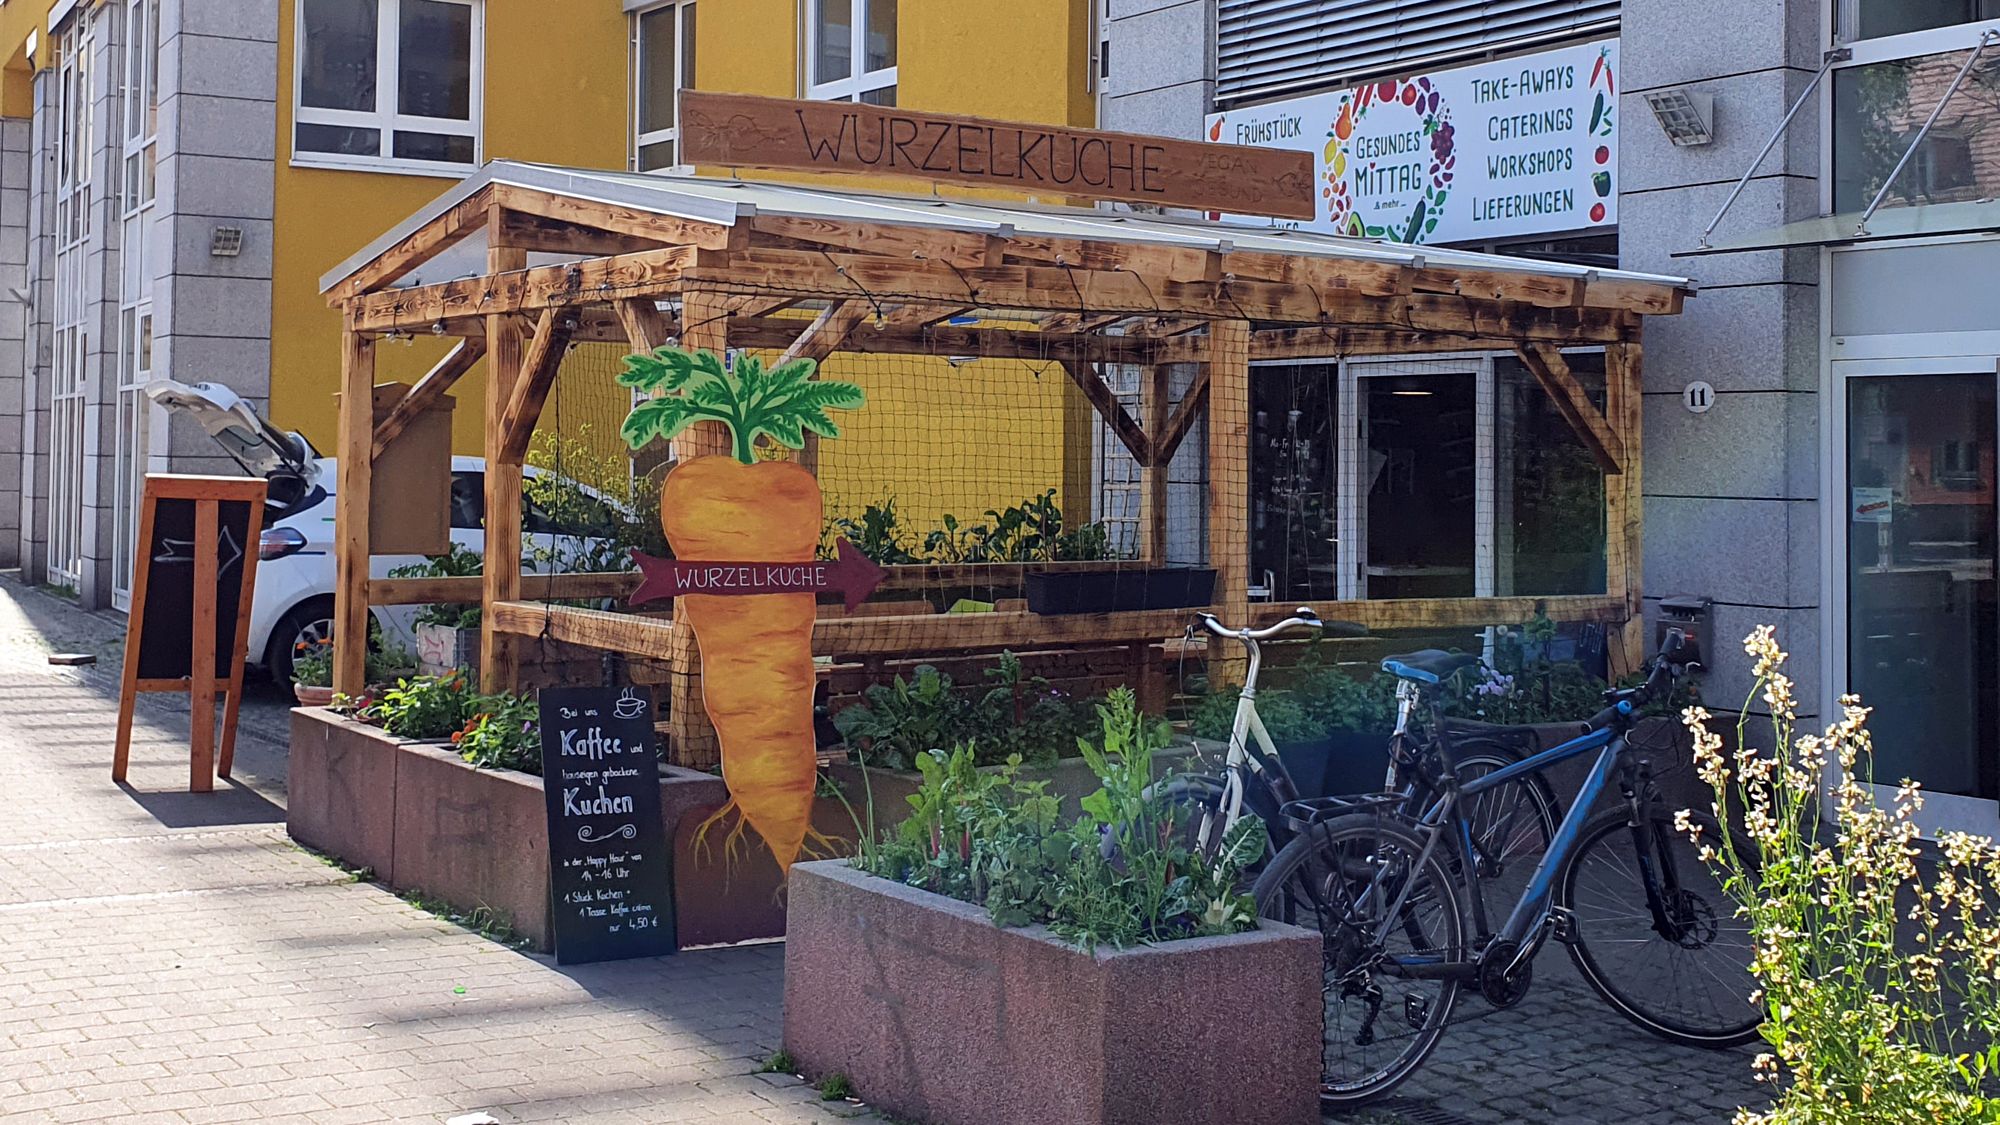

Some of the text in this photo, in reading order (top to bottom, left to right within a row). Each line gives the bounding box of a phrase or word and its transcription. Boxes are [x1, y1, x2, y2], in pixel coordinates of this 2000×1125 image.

[1471, 65, 1574, 104] TAKE-AWAYS
[1236, 113, 1302, 145] FRÜHSTÜCK
[1488, 107, 1573, 142] CATERINGS
[795, 109, 1165, 193] WURZELKÜCHE
[1356, 130, 1420, 159] GESUNDES
[1198, 153, 1258, 175] VEGAN
[1487, 147, 1573, 180] WORKSHOPS
[1472, 188, 1574, 222] LIEFERUNGEN
[1689, 387, 1708, 407] 11
[674, 567, 827, 589] WURZELKÜCHE
[560, 707, 578, 719] Bei
[560, 726, 643, 760] Kaffee und
[563, 785, 634, 817] Kuchen
[572, 858, 583, 866] der
[616, 867, 630, 878] Uhr
[596, 888, 624, 901] Kuchen
[586, 906, 607, 917] Tasse
[609, 924, 621, 932] nur
[629, 916, 649, 930] 4,50
